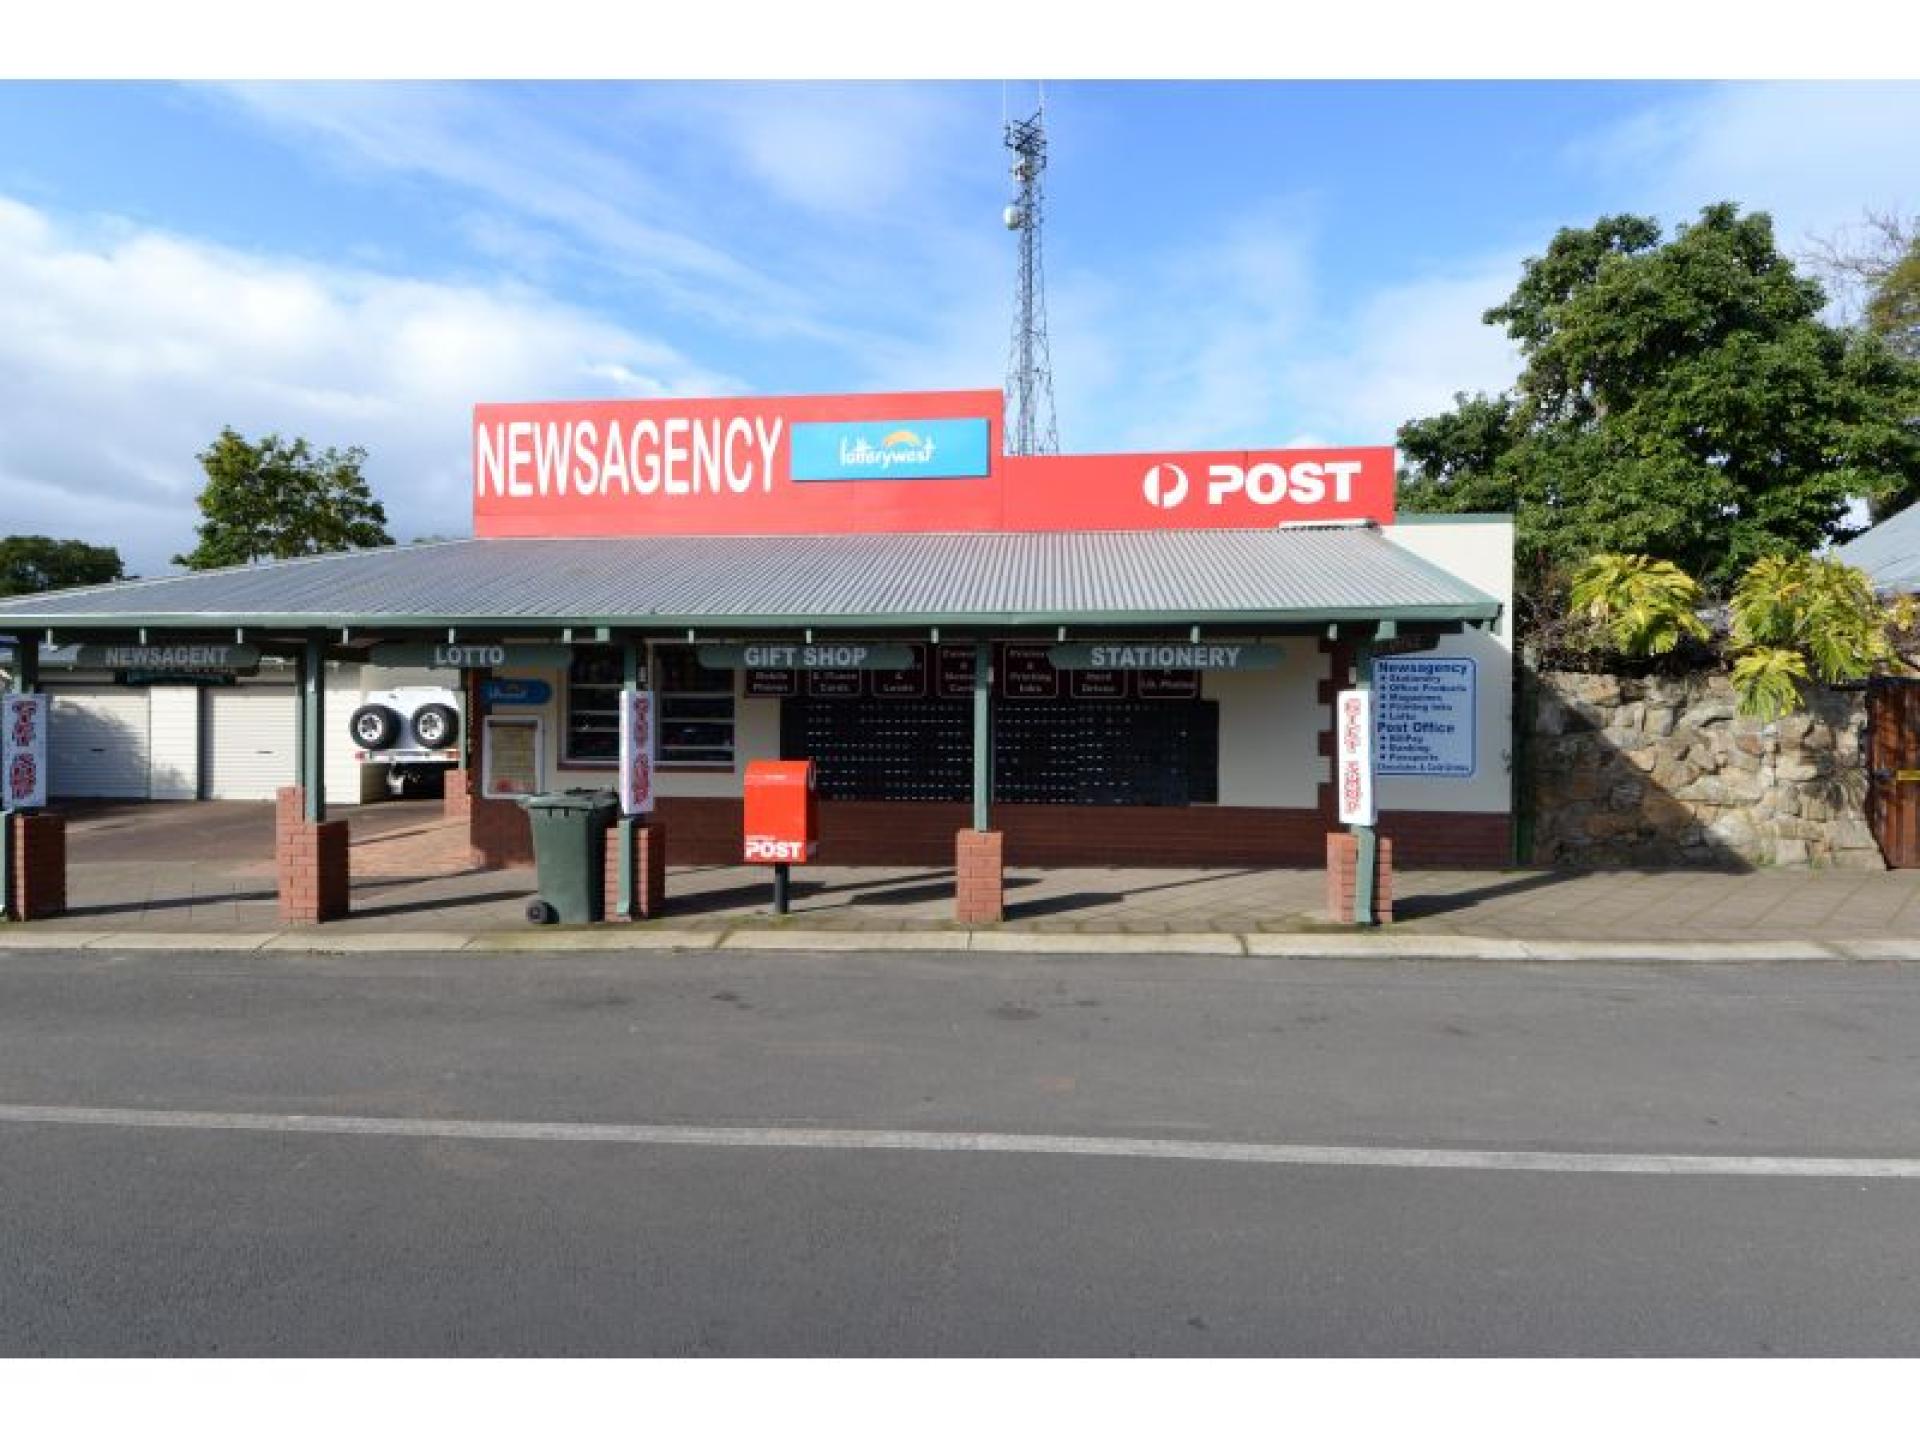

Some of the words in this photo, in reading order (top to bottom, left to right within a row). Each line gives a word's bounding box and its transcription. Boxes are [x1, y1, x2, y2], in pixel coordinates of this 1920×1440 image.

[477, 416, 784, 498] NEWSAGENCY
[839, 432, 937, 469] lotterywest
[1208, 460, 1362, 505] POST
[105, 647, 229, 667] NEWSAGENT
[434, 646, 504, 665] LOTTO
[743, 647, 797, 666] GIFT
[803, 647, 867, 666] SHOP
[1091, 647, 1241, 666] STATIONERY
[1377, 662, 1467, 676] Newsagency
[1389, 674, 1441, 683] Stationery
[1377, 721, 1408, 732] Post
[1412, 721, 1456, 732] Office
[745, 841, 802, 858] POST
